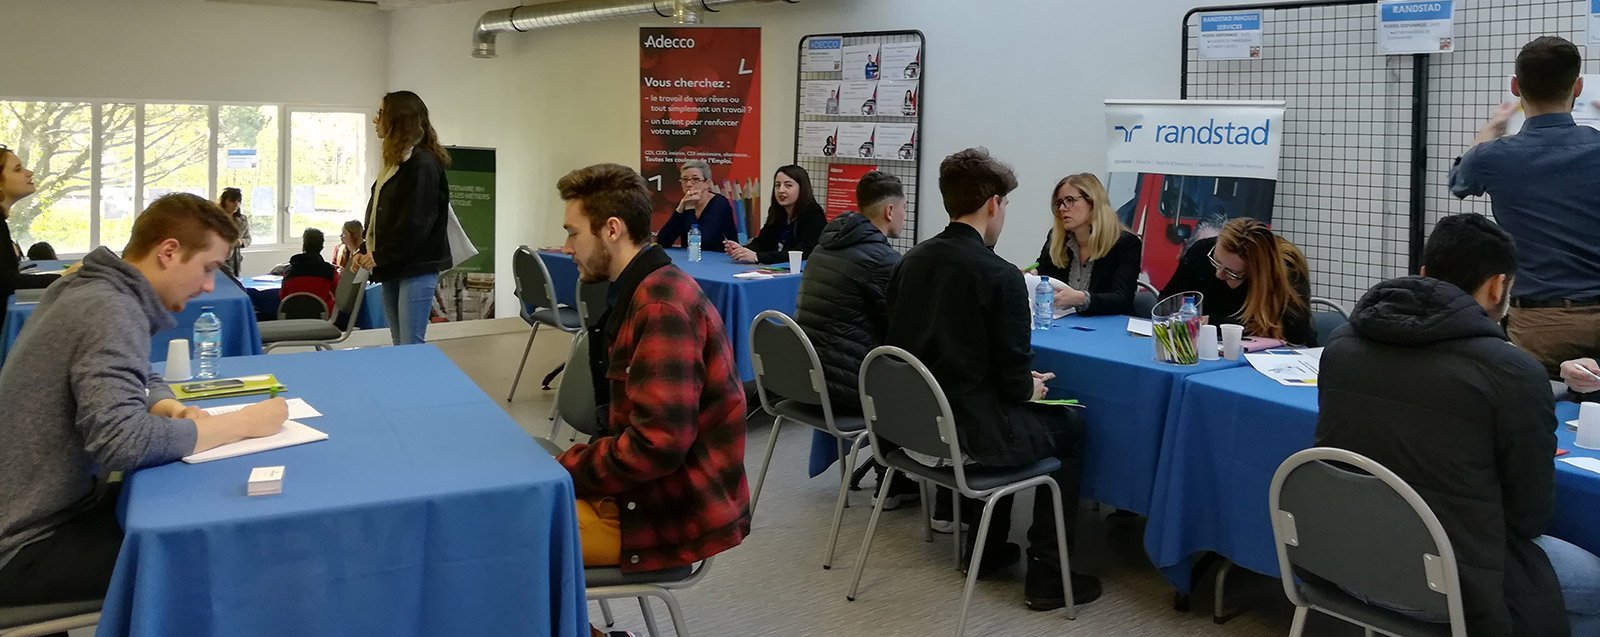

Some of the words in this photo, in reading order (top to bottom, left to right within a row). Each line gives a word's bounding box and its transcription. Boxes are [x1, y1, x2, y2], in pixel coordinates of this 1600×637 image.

[1392, 4, 1441, 13] RANDSTAD
[644, 35, 695, 48] Adecco
[811, 40, 839, 49] ADECCO
[644, 77, 671, 87] Vous
[674, 78, 724, 88] cherchez
[709, 95, 728, 103] rêves
[668, 105, 709, 113] simplement
[1155, 118, 1270, 145] randstad
